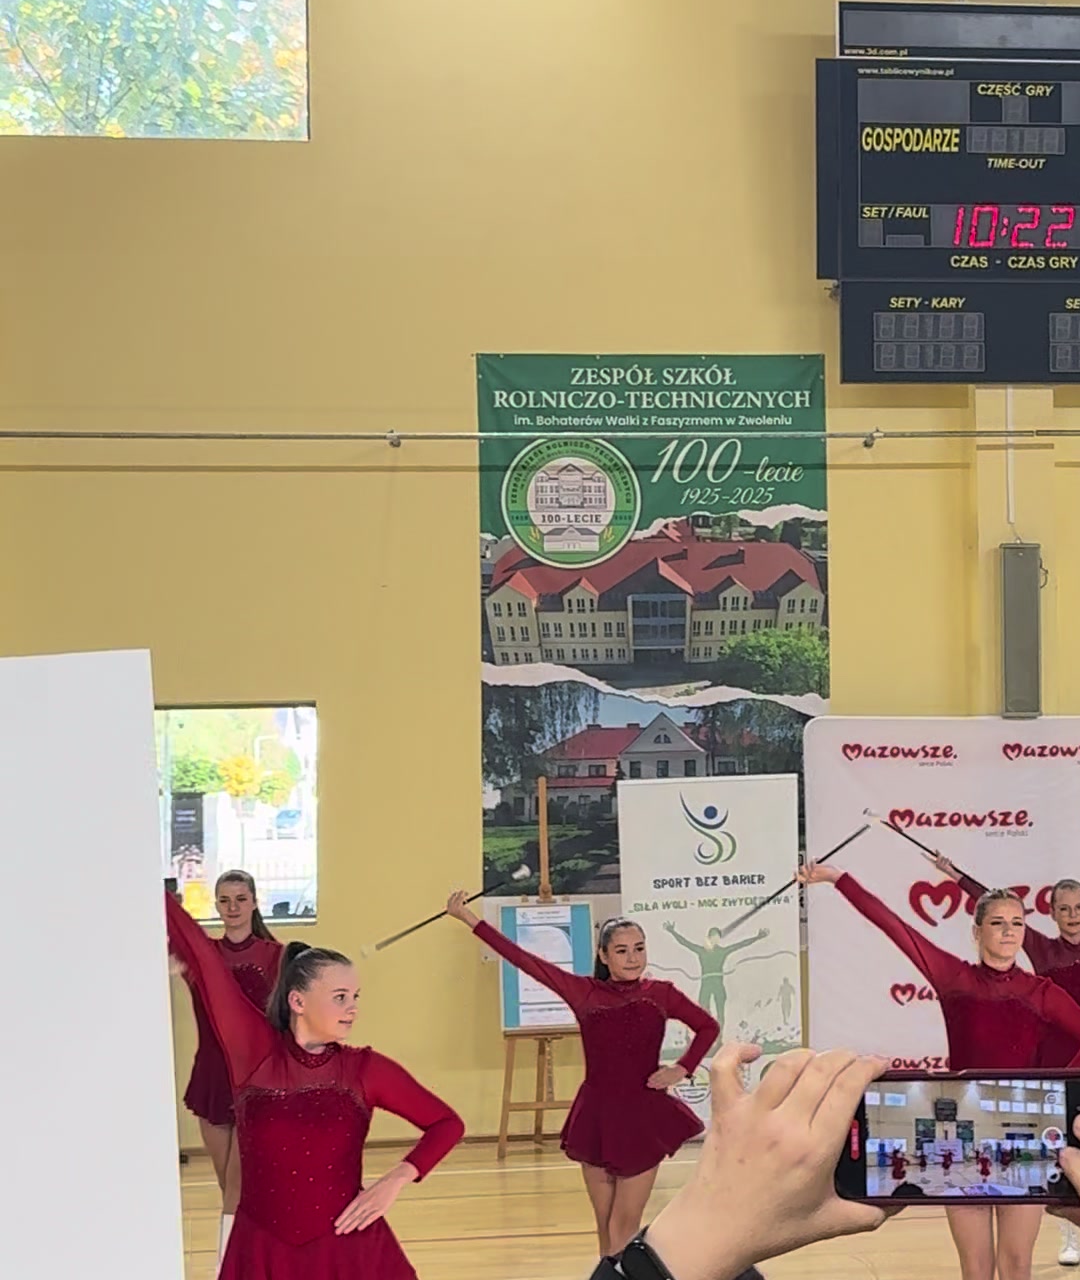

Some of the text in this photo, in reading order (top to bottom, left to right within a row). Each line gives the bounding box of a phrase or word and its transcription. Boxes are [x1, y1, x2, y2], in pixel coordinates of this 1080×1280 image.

[843, 48, 908, 57] www.3d.com.pl
[977, 82, 1054, 98] CZĘŚĆ GRY
[861, 127, 960, 153] GOSPODARZE
[986, 158, 1046, 169] TIME-OUT
[952, 204, 1075, 248] 10:22
[950, 256, 988, 268] CZAS
[1007, 256, 1046, 269] CZAS
[1049, 256, 1079, 269] GRY
[889, 297, 922, 309] SETY
[931, 297, 966, 309] KARY
[570, 363, 737, 386] ZESPÓŁ SZKÓŁ
[493, 390, 812, 410] ROLNICZO-TECHNICZNYCH
[514, 414, 792, 429] im. Bohaterów Walki z Faszyzmem w Zwoleniu
[680, 486, 775, 505] 1925-2025
[541, 514, 602, 524] 100-LECIE
[653, 874, 766, 890] SPORT BEZ BARIER
[662, 900, 688, 910] WOLI
[697, 898, 719, 908] MOC
